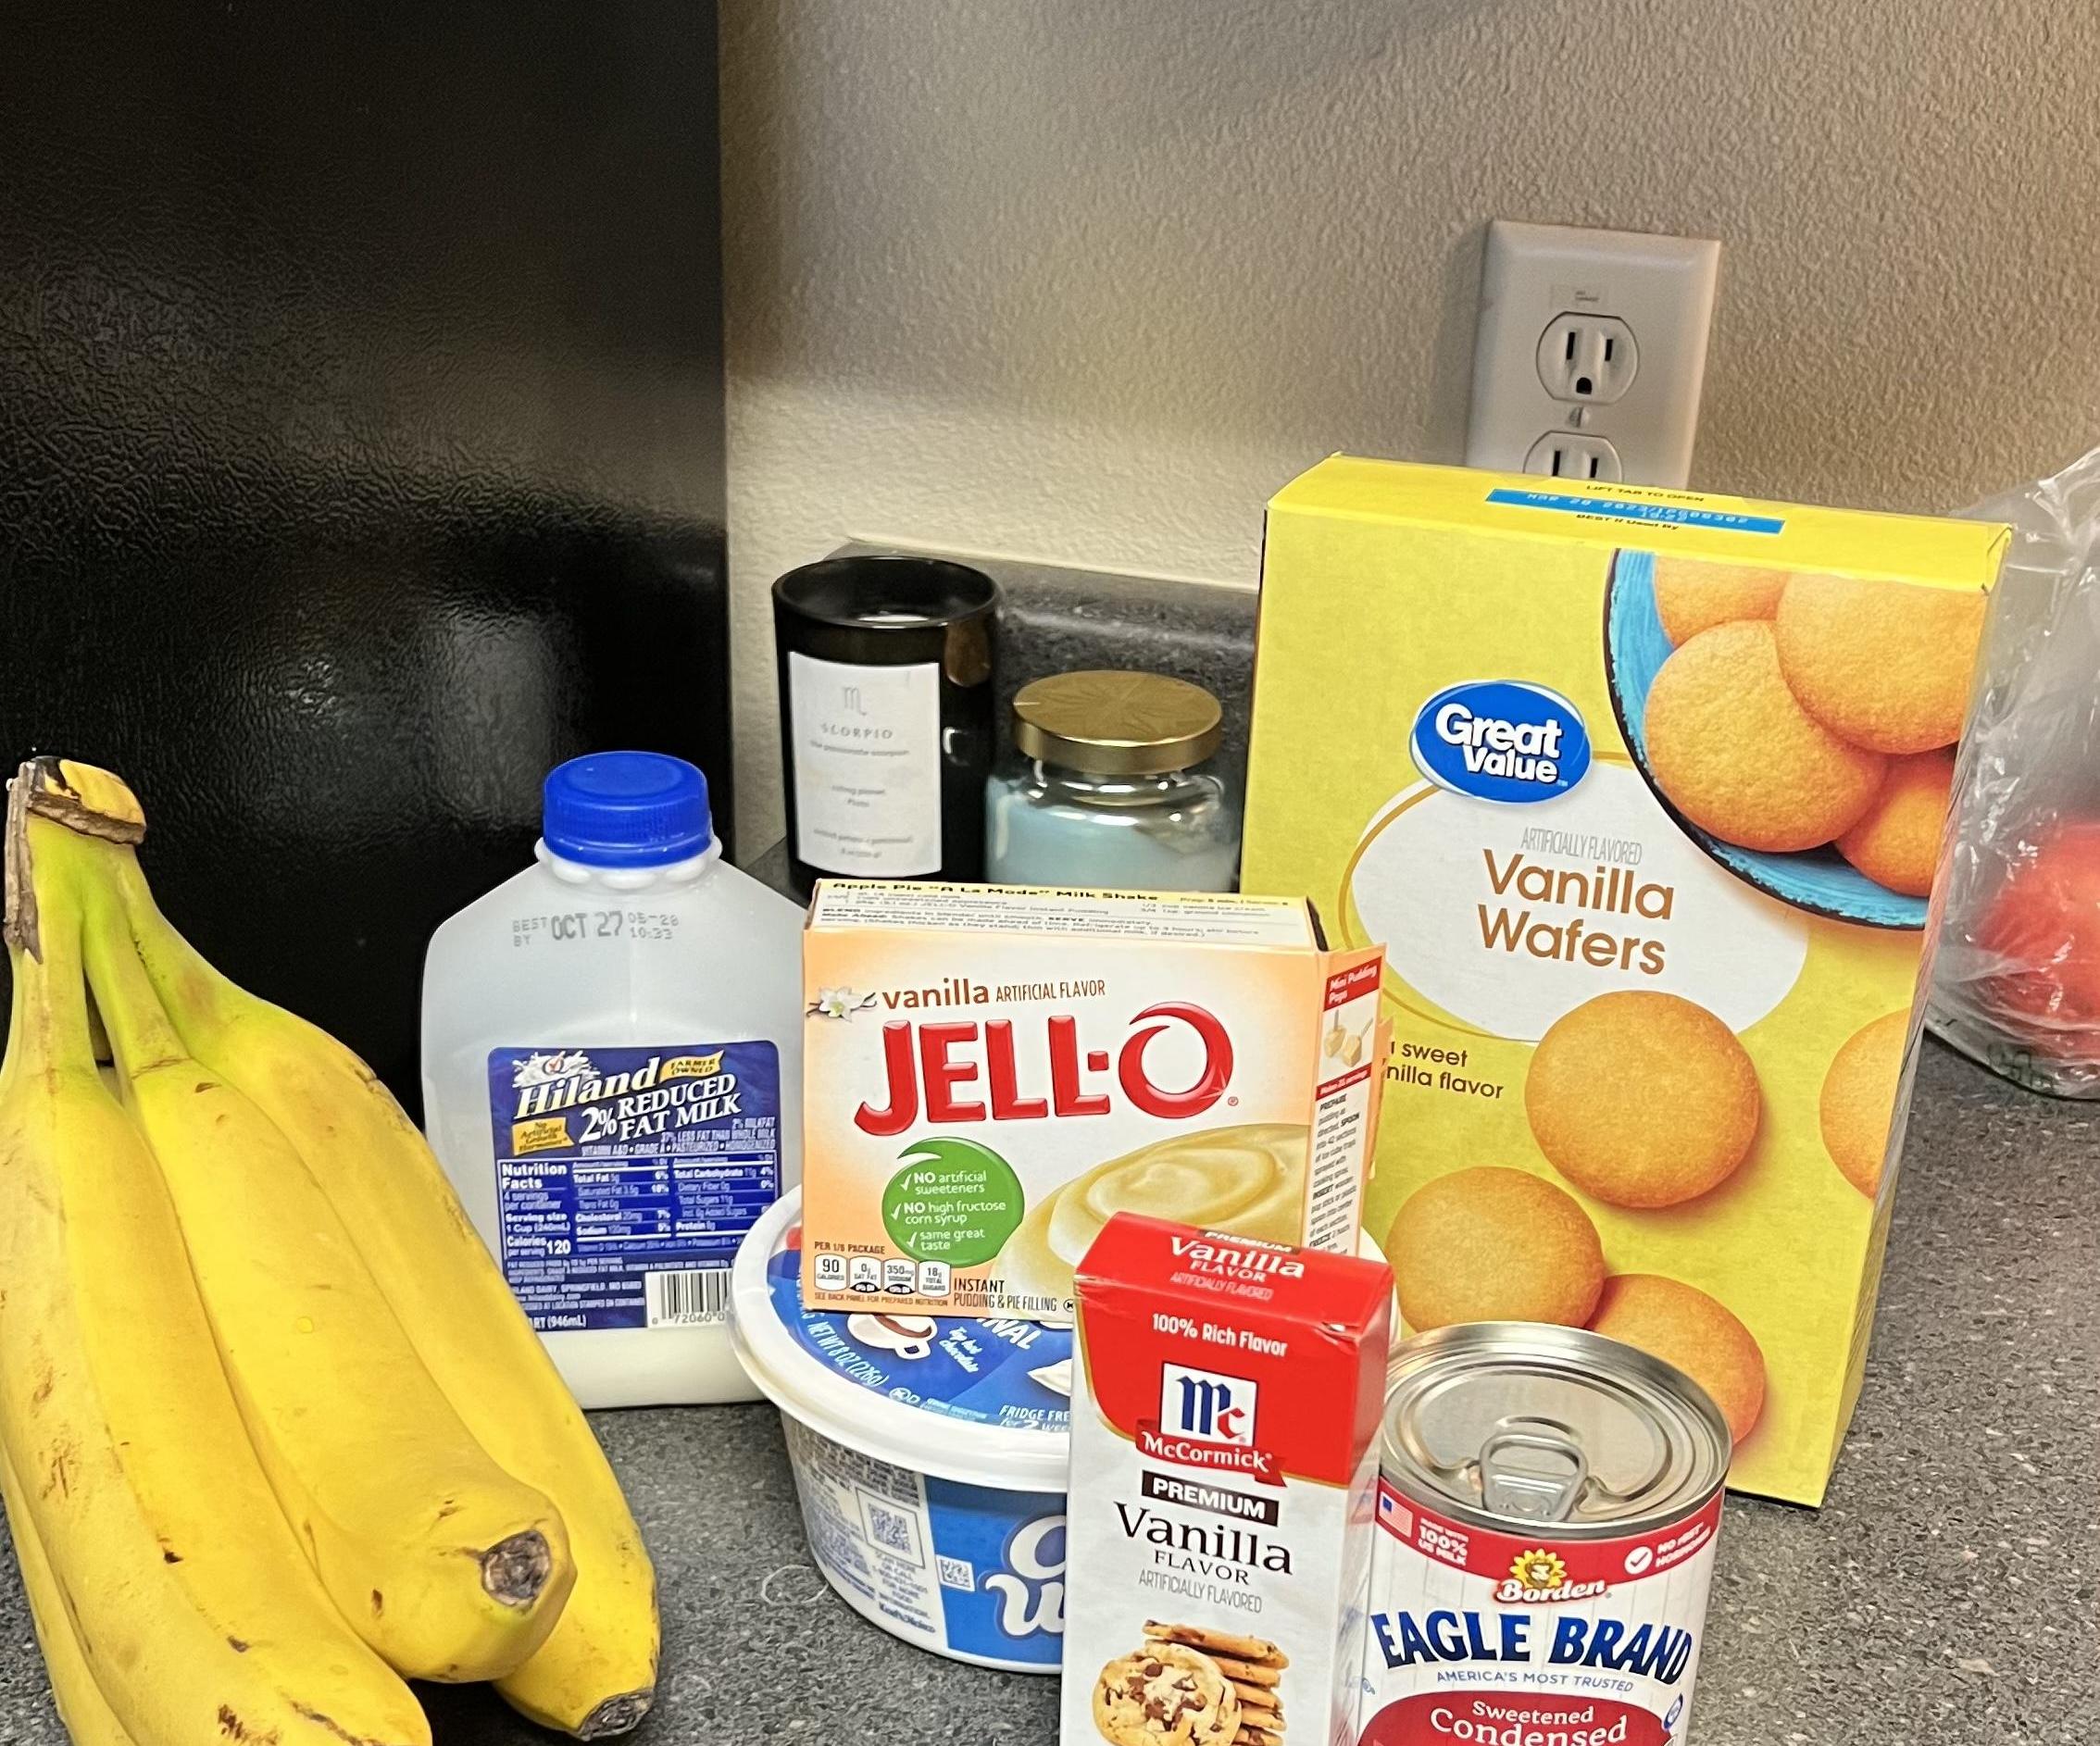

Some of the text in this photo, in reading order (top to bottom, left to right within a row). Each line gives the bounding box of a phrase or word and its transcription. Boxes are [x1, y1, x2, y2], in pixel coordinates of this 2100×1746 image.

[1667, 493, 1704, 502] OPEN
[821, 723, 894, 740] SCORPIO
[1433, 702, 1563, 758] Great
[1462, 745, 1559, 784] Value
[1520, 827, 1643, 867] ARTIFICIALLY FLAVORED
[1482, 848, 1674, 921] Vanilla
[512, 917, 547, 933] BEST
[551, 912, 588, 941] OCT
[594, 910, 623, 938] 27
[514, 934, 532, 947] BY
[1477, 904, 1667, 976] Wafers
[1348, 964, 1378, 985] Pudding
[881, 978, 1106, 1010] vanilla ARTIFICIAL FLAVOR
[1401, 1042, 1468, 1067] sweet
[854, 1001, 1234, 1137] JELL-O
[513, 1055, 661, 1119] Hiland
[1387, 1064, 1432, 1087] nilla
[1439, 1071, 1505, 1100] flavor
[617, 1073, 737, 1120] REDUCED
[579, 1106, 618, 1143] 2%
[619, 1092, 743, 1142] FAT MILK
[502, 1162, 568, 1177] Nutrition
[914, 1170, 987, 1184] NO artificial
[502, 1178, 543, 1190] Facts
[915, 1183, 984, 1195] sweeteners
[506, 1212, 568, 1223] Serving size
[904, 1200, 1006, 1216] NO high fructose
[905, 1213, 968, 1227] corn syrup
[513, 1223, 532, 1234] Cup
[920, 1228, 986, 1241] same great
[507, 1236, 547, 1247] Calories
[546, 1239, 571, 1255] 120
[815, 1241, 831, 1251] PER
[848, 1244, 885, 1254] PACKAGE
[920, 1241, 951, 1252] taste
[1205, 1231, 1293, 1253] PREMIUM
[822, 1258, 840, 1273] 90
[1169, 1237, 1306, 1278] Vanilla
[1190, 1261, 1267, 1282] FLAVOR
[954, 1277, 1006, 1293] INSTANT
[1169, 1271, 1274, 1301] ARTIFICIALLY FLAVORED
[954, 1292, 995, 1308] PUDDING
[997, 1296, 1006, 1309] &
[1007, 1297, 1021, 1310] PIE
[1022, 1298, 1057, 1312] FILLING
[547, 1315, 587, 1329] (946mL)
[1152, 1313, 1288, 1357] 100% Rich Flavor
[999, 1404, 1045, 1421] FRIDGE
[1047, 1410, 1071, 1422] FRE
[1142, 1430, 1269, 1474] McCormick
[1152, 1478, 1267, 1519] PREMIUM
[1113, 1501, 1294, 1575] Vanilla
[1419, 1525, 1469, 1556] 100%
[1656, 1539, 1677, 1554] NO
[1155, 1549, 1251, 1586] FLAVOR
[1138, 1569, 1263, 1615] ARTIFICIALLY FLAVORED
[1496, 1579, 1606, 1603] Borden
[1370, 1611, 1693, 1686] EAGLE BRAND
[1437, 1670, 1633, 1692] AMERICA'S MOST TRUSTED
[1472, 1700, 1594, 1726] Sweetened
[1430, 1707, 1628, 1746] Condensed
